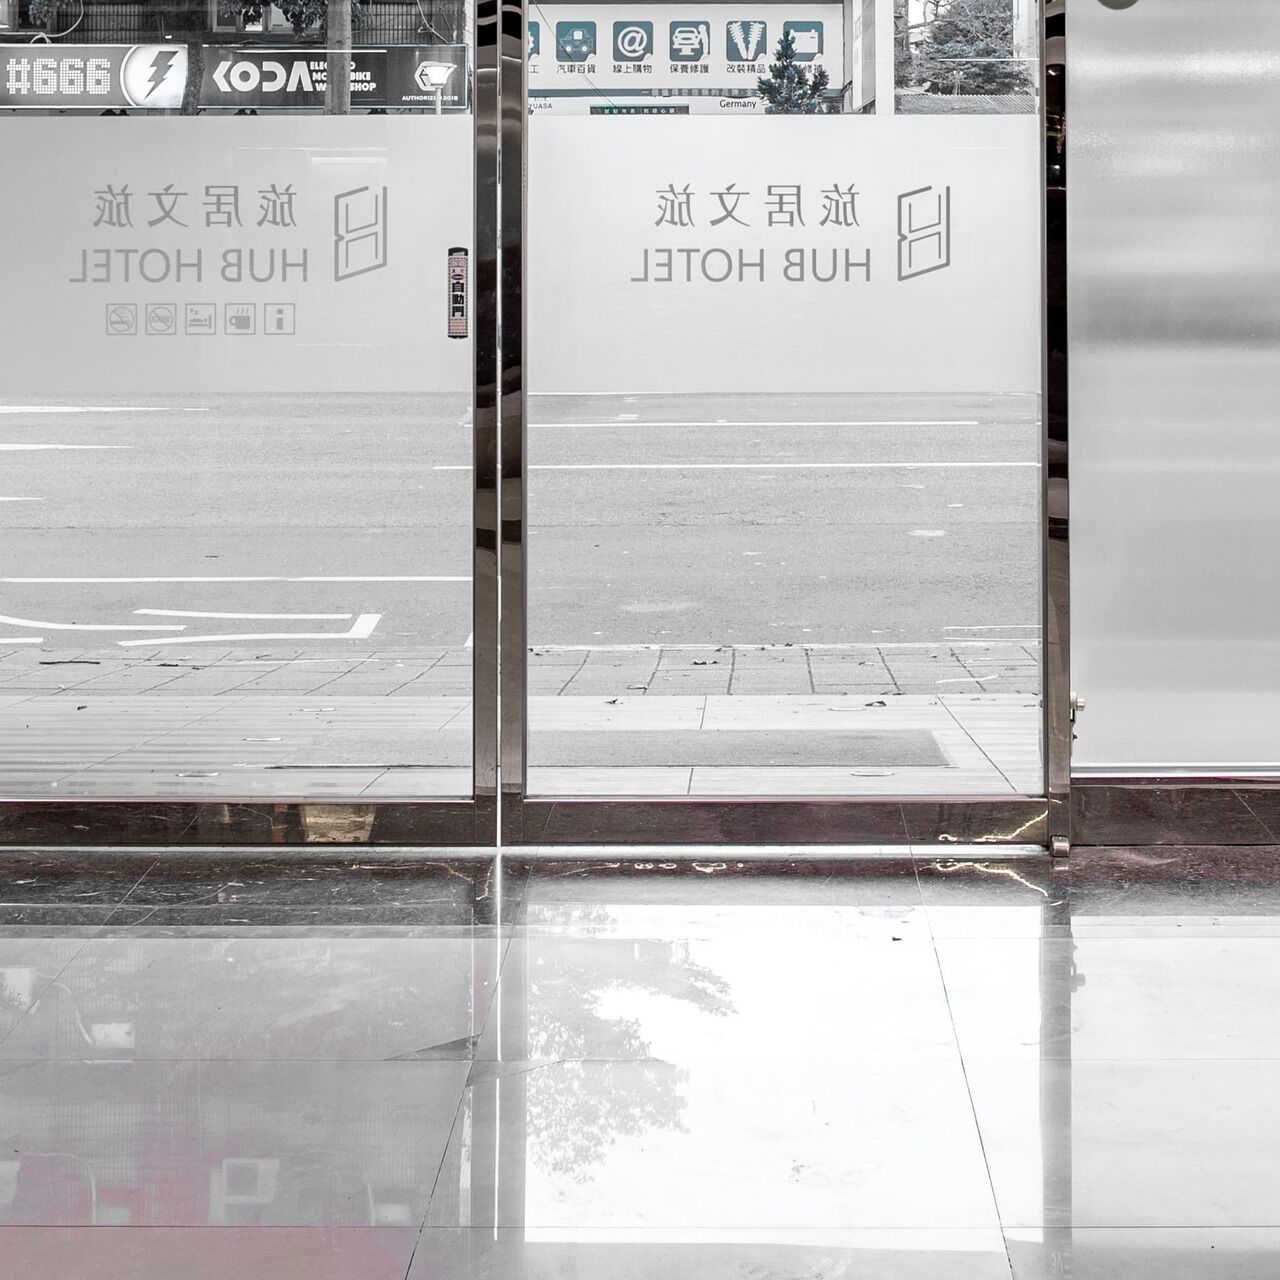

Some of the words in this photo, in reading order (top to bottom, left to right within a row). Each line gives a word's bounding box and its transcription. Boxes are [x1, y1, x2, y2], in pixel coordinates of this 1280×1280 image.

[556, 64, 596, 74] 汽車百貨
[612, 64, 652, 74] 線上購物
[669, 64, 709, 74] 保養修護
[726, 64, 766, 74] 改裝精品
[7, 58, 111, 95] #666
[315, 82, 377, 92] WSHOP
[719, 99, 757, 109] Germany
